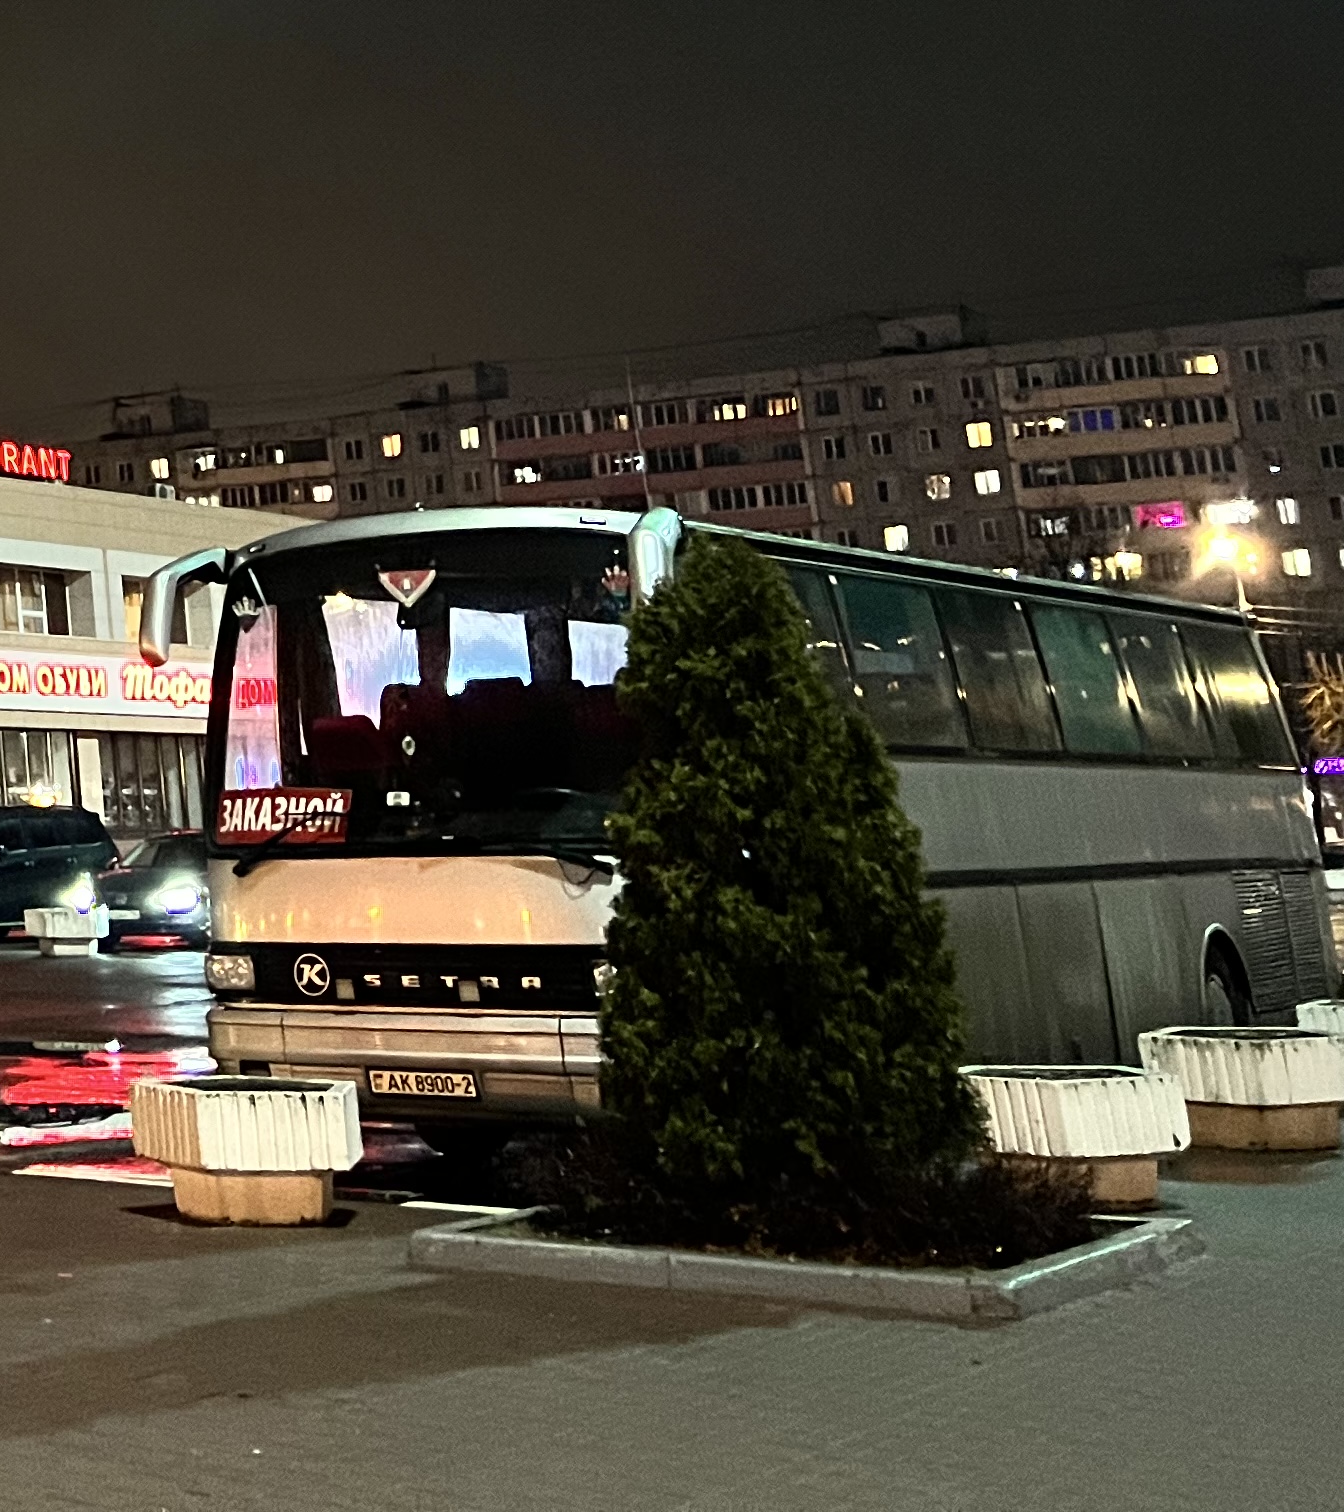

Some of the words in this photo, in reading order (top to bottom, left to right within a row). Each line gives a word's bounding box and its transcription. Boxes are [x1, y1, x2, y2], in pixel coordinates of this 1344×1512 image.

[36, 665, 106, 696] ОБУВИ
[219, 792, 344, 832] ЗАКАЗНОЙ
[363, 974, 541, 989] SETRA
